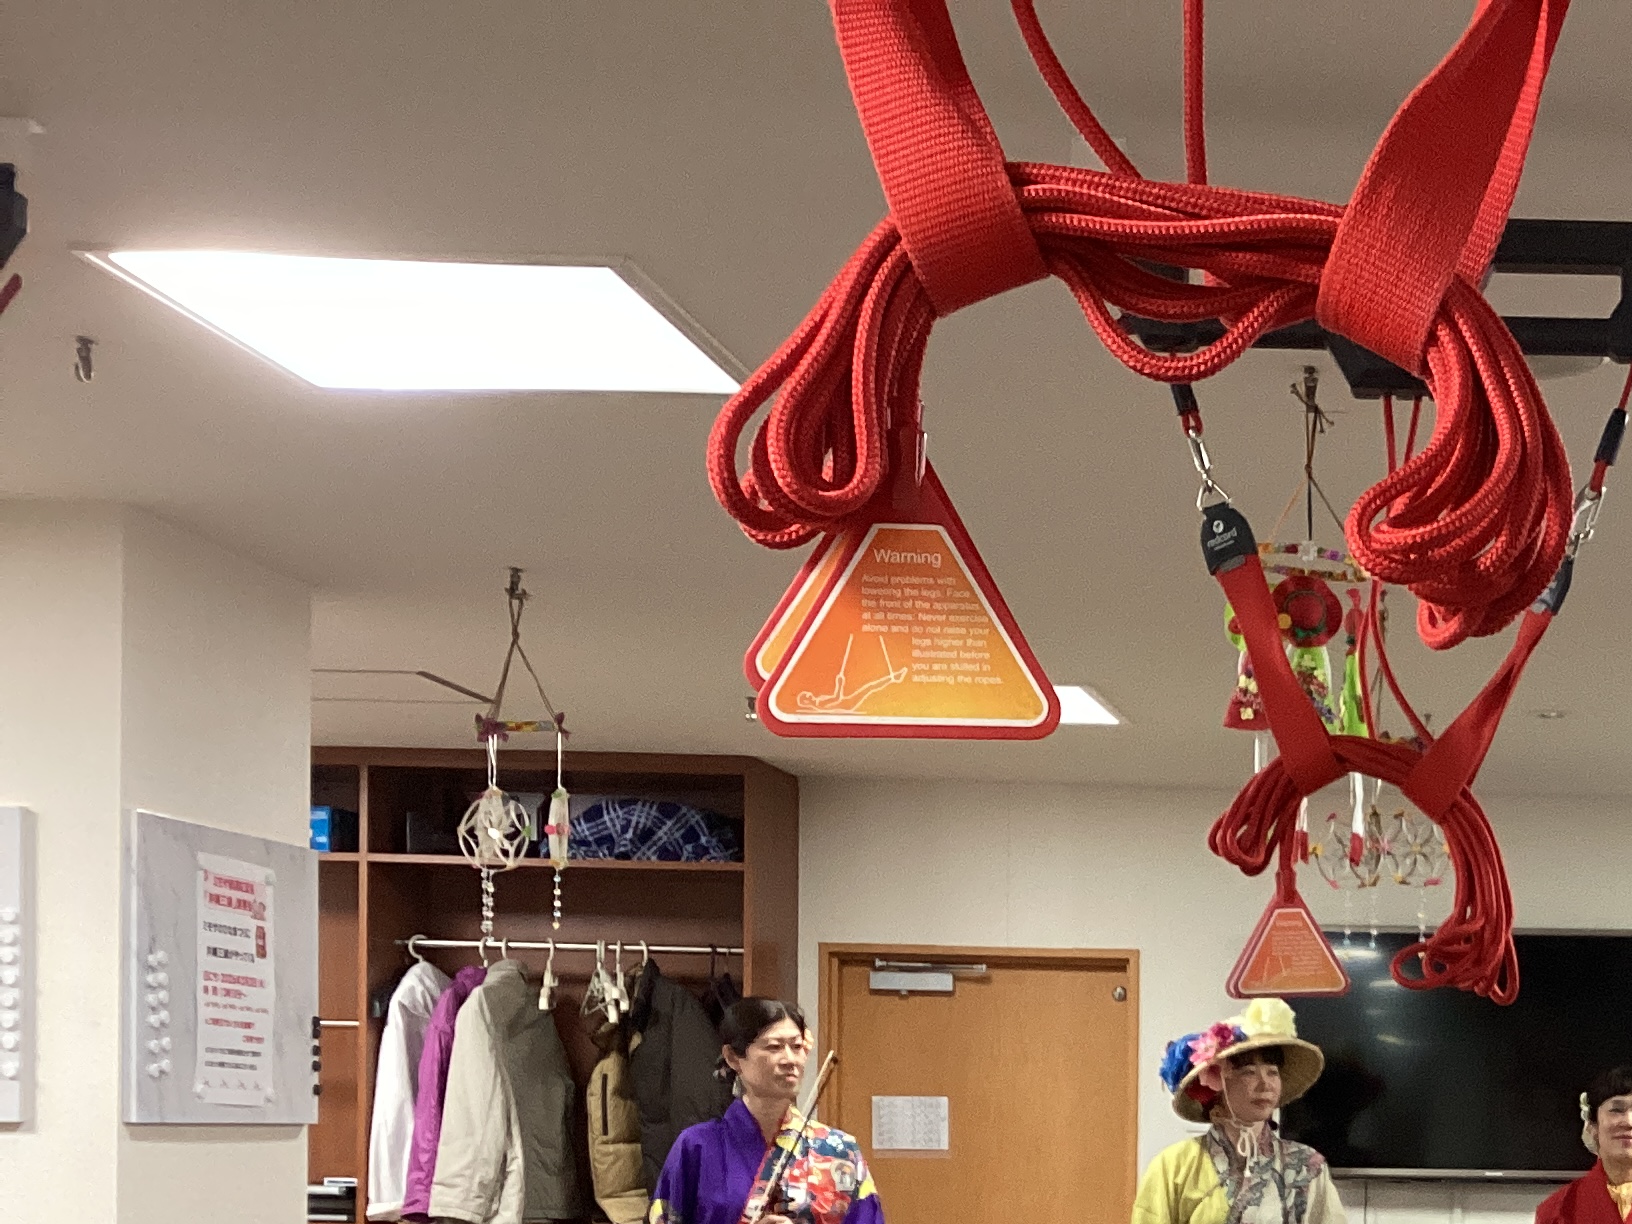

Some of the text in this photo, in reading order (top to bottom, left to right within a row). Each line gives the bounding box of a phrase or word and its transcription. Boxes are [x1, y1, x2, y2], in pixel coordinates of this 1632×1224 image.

[873, 547, 942, 568] Warning
[890, 575, 935, 586] problems
[903, 587, 919, 597] the
[946, 588, 971, 598] Face
[861, 599, 877, 609] the
[880, 599, 902, 609] front
[903, 599, 913, 609] of
[915, 600, 931, 610] the
[861, 611, 872, 621] at
[874, 611, 886, 621] all
[918, 612, 947, 622] Never
[949, 613, 989, 623] exercise
[862, 623, 889, 633] alone
[891, 623, 909, 633] and
[911, 624, 924, 633] do
[926, 624, 941, 634] not
[969, 627, 990, 636] your
[911, 636, 988, 648] legs higher than
[960, 649, 991, 660] before
[911, 662, 930, 671] you
[931, 662, 948, 671] are
[912, 674, 955, 685] adjusting
[957, 674, 972, 684] the
